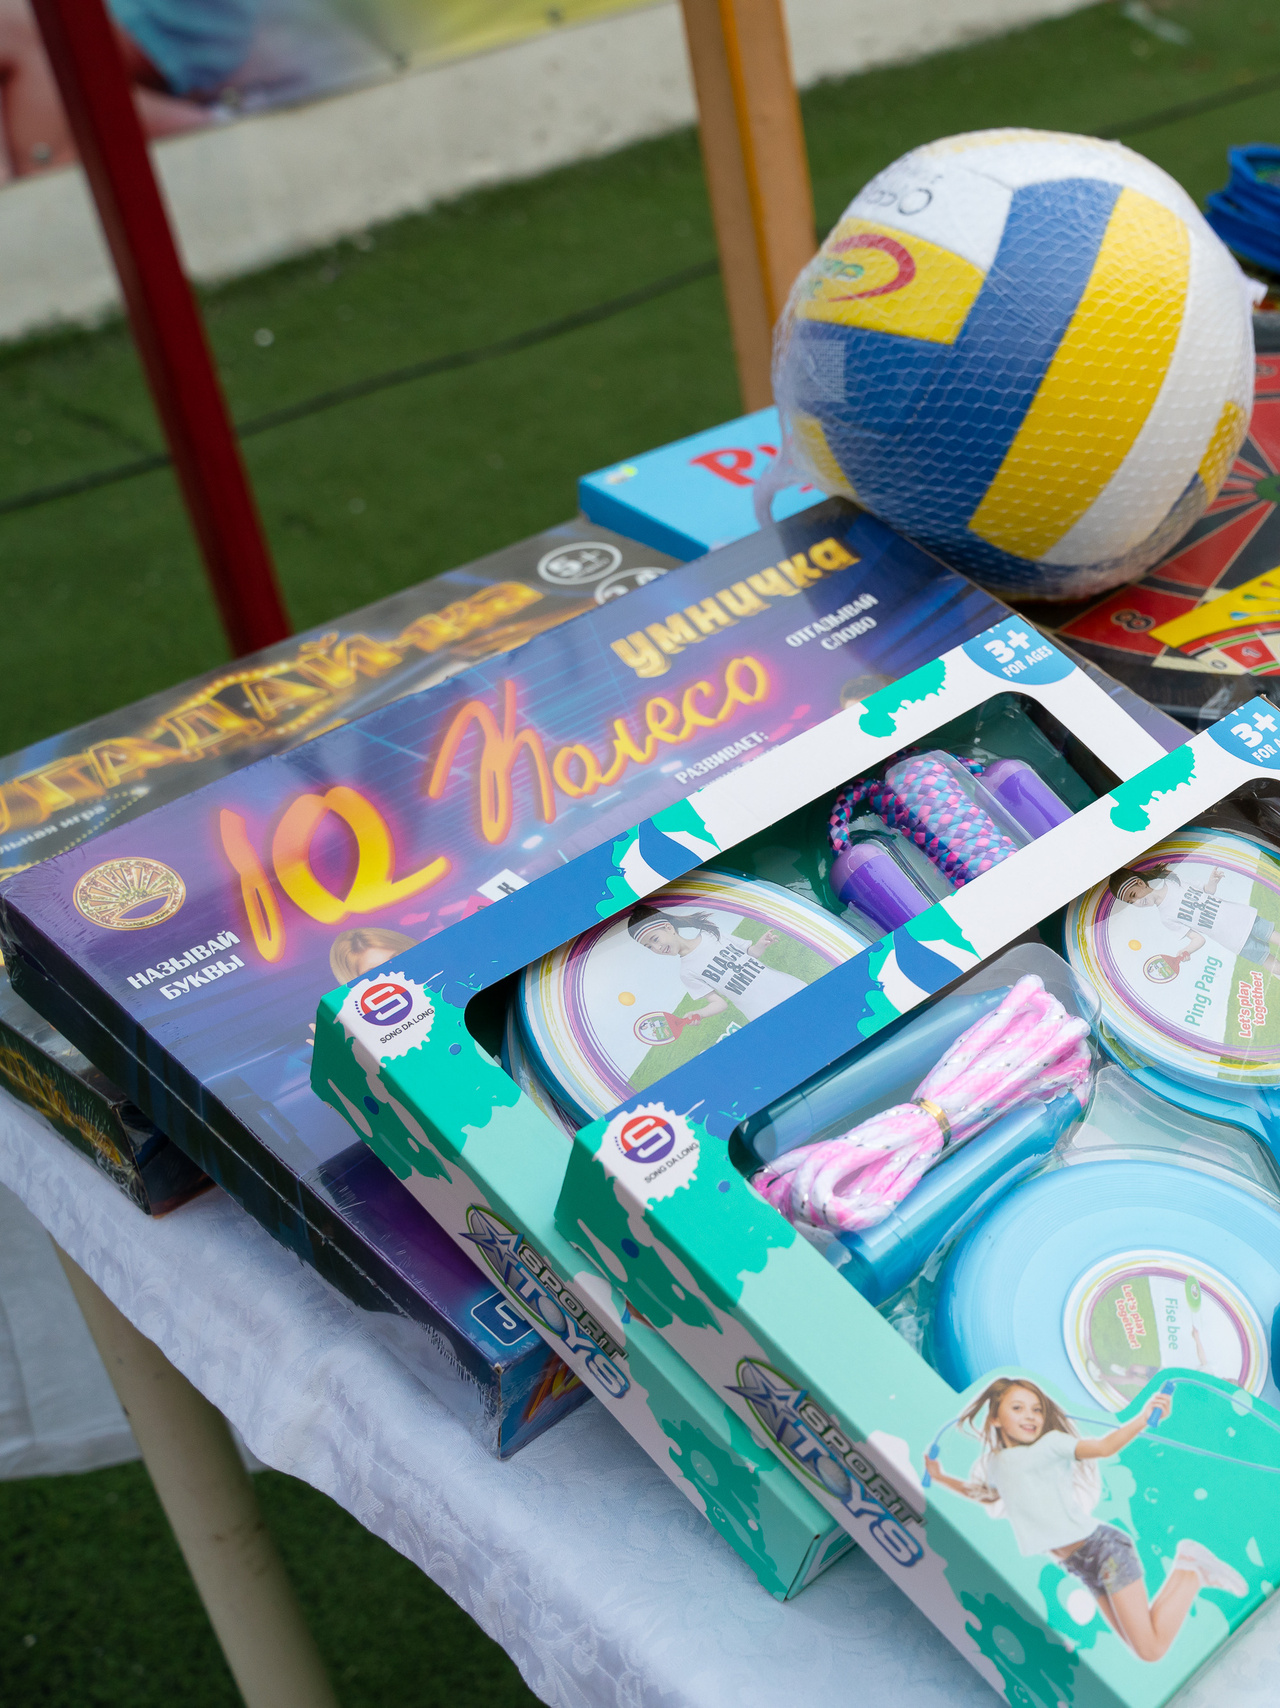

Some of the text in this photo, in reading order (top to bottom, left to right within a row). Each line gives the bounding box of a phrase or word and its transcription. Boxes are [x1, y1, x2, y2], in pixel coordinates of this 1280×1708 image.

[785, 592, 879, 648] ОТГАДЫВАЙ
[820, 616, 877, 651] СЛОВО
[984, 629, 1031, 664] 3+
[1001, 645, 1054, 678] FOR AGES
[427, 655, 768, 845] Колесо
[1230, 711, 1279, 749] 3+
[1251, 744, 1278, 763] FOR
[674, 730, 769, 785] РАЗВИВАЕТ:
[1177, 885, 1203, 923] BLACK
[1193, 901, 1207, 912] &
[1198, 895, 1222, 929] WHITE
[126, 929, 241, 991] НАЗЫВАЙ
[158, 954, 246, 1001] БУКВЫ
[701, 943, 746, 983] BLACK
[724, 958, 766, 996] WHITE
[727, 961, 744, 974] &
[1184, 954, 1223, 1027] Ping Pang
[1237, 980, 1252, 1038] Let's play
[1251, 971, 1268, 1026] together!
[380, 1007, 435, 1044] SONG DA LONG
[644, 1142, 699, 1184] SONG DA LONG
[518, 1245, 629, 1361] SPORT
[1115, 1299, 1141, 1349] together!
[1121, 1284, 1147, 1336] Let's play
[1164, 1297, 1181, 1350] Fise bee
[514, 1261, 630, 1399] TOYS
[799, 1401, 927, 1528] SPORT
[789, 1418, 924, 1568] TOYS
